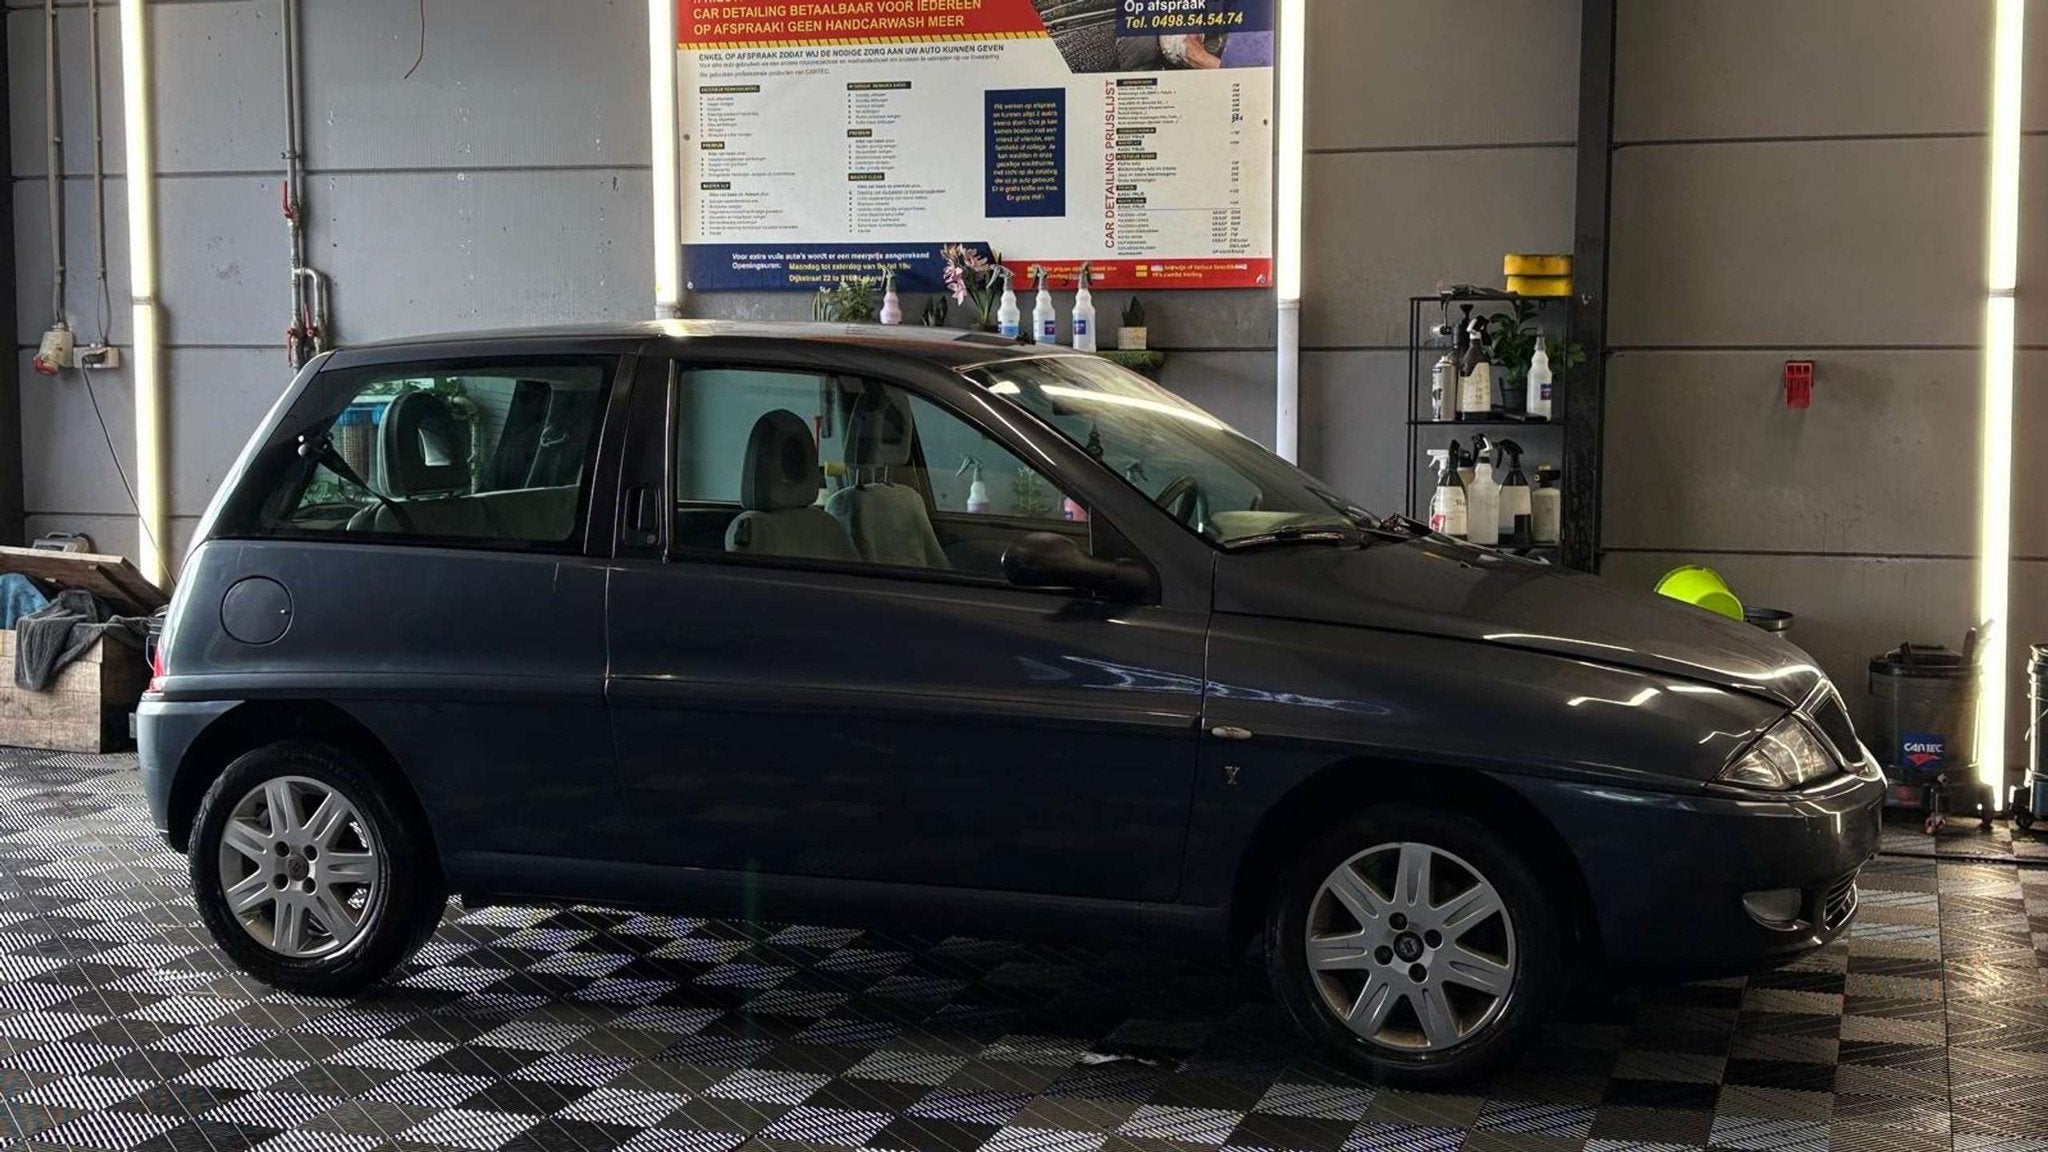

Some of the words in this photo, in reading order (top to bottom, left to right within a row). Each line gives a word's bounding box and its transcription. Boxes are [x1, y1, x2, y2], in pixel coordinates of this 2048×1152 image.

[693, 8, 720, 20] CAR
[722, 5, 787, 18] DETAILING
[789, 2, 874, 16] BETAALBAAR
[877, 1, 914, 13] VOOR
[917, 0, 982, 11] IEDEREEN
[1124, 0, 1144, 14] Op
[1147, 0, 1206, 12] afspraak
[693, 24, 711, 35] OP
[713, 21, 784, 35] AFSPRAAK!
[787, 20, 823, 33] GEEN
[825, 16, 925, 31] HANDCARWASH
[927, 15, 965, 28] MEER
[1125, 16, 1148, 29] Tel.
[1151, 12, 1244, 28] 0498.54.54.74
[699, 53, 722, 61] ENKEL
[724, 53, 736, 61] OP
[737, 51, 777, 60] AFSPRAAK
[779, 51, 803, 59] ZODAT
[805, 50, 819, 58] WIJ
[820, 50, 831, 58] DE
[832, 48, 862, 57] NODIGE
[863, 47, 886, 56] ZORG
[887, 47, 904, 55] AAN
[905, 47, 919, 55] UW
[920, 46, 941, 54] AUTO
[942, 45, 975, 54] KUNNEN
[976, 44, 1004, 52] GEVEN
[1105, 80, 1116, 150] PRIJSLIJST
[1105, 153, 1115, 219] DETAILING
[1105, 222, 1115, 249] CAR
[732, 252, 748, 260] Voor
[749, 252, 767, 260] extra
[768, 252, 783, 260] vuile
[785, 252, 806, 260] auto's
[807, 252, 827, 260] wordt
[851, 252, 883, 262] meerprijs
[732, 262, 782, 270] Openingsuren:
[789, 262, 820, 271] Maandag
[832, 262, 862, 271] zaterdag
[788, 274, 821, 283] Dijkstraat
